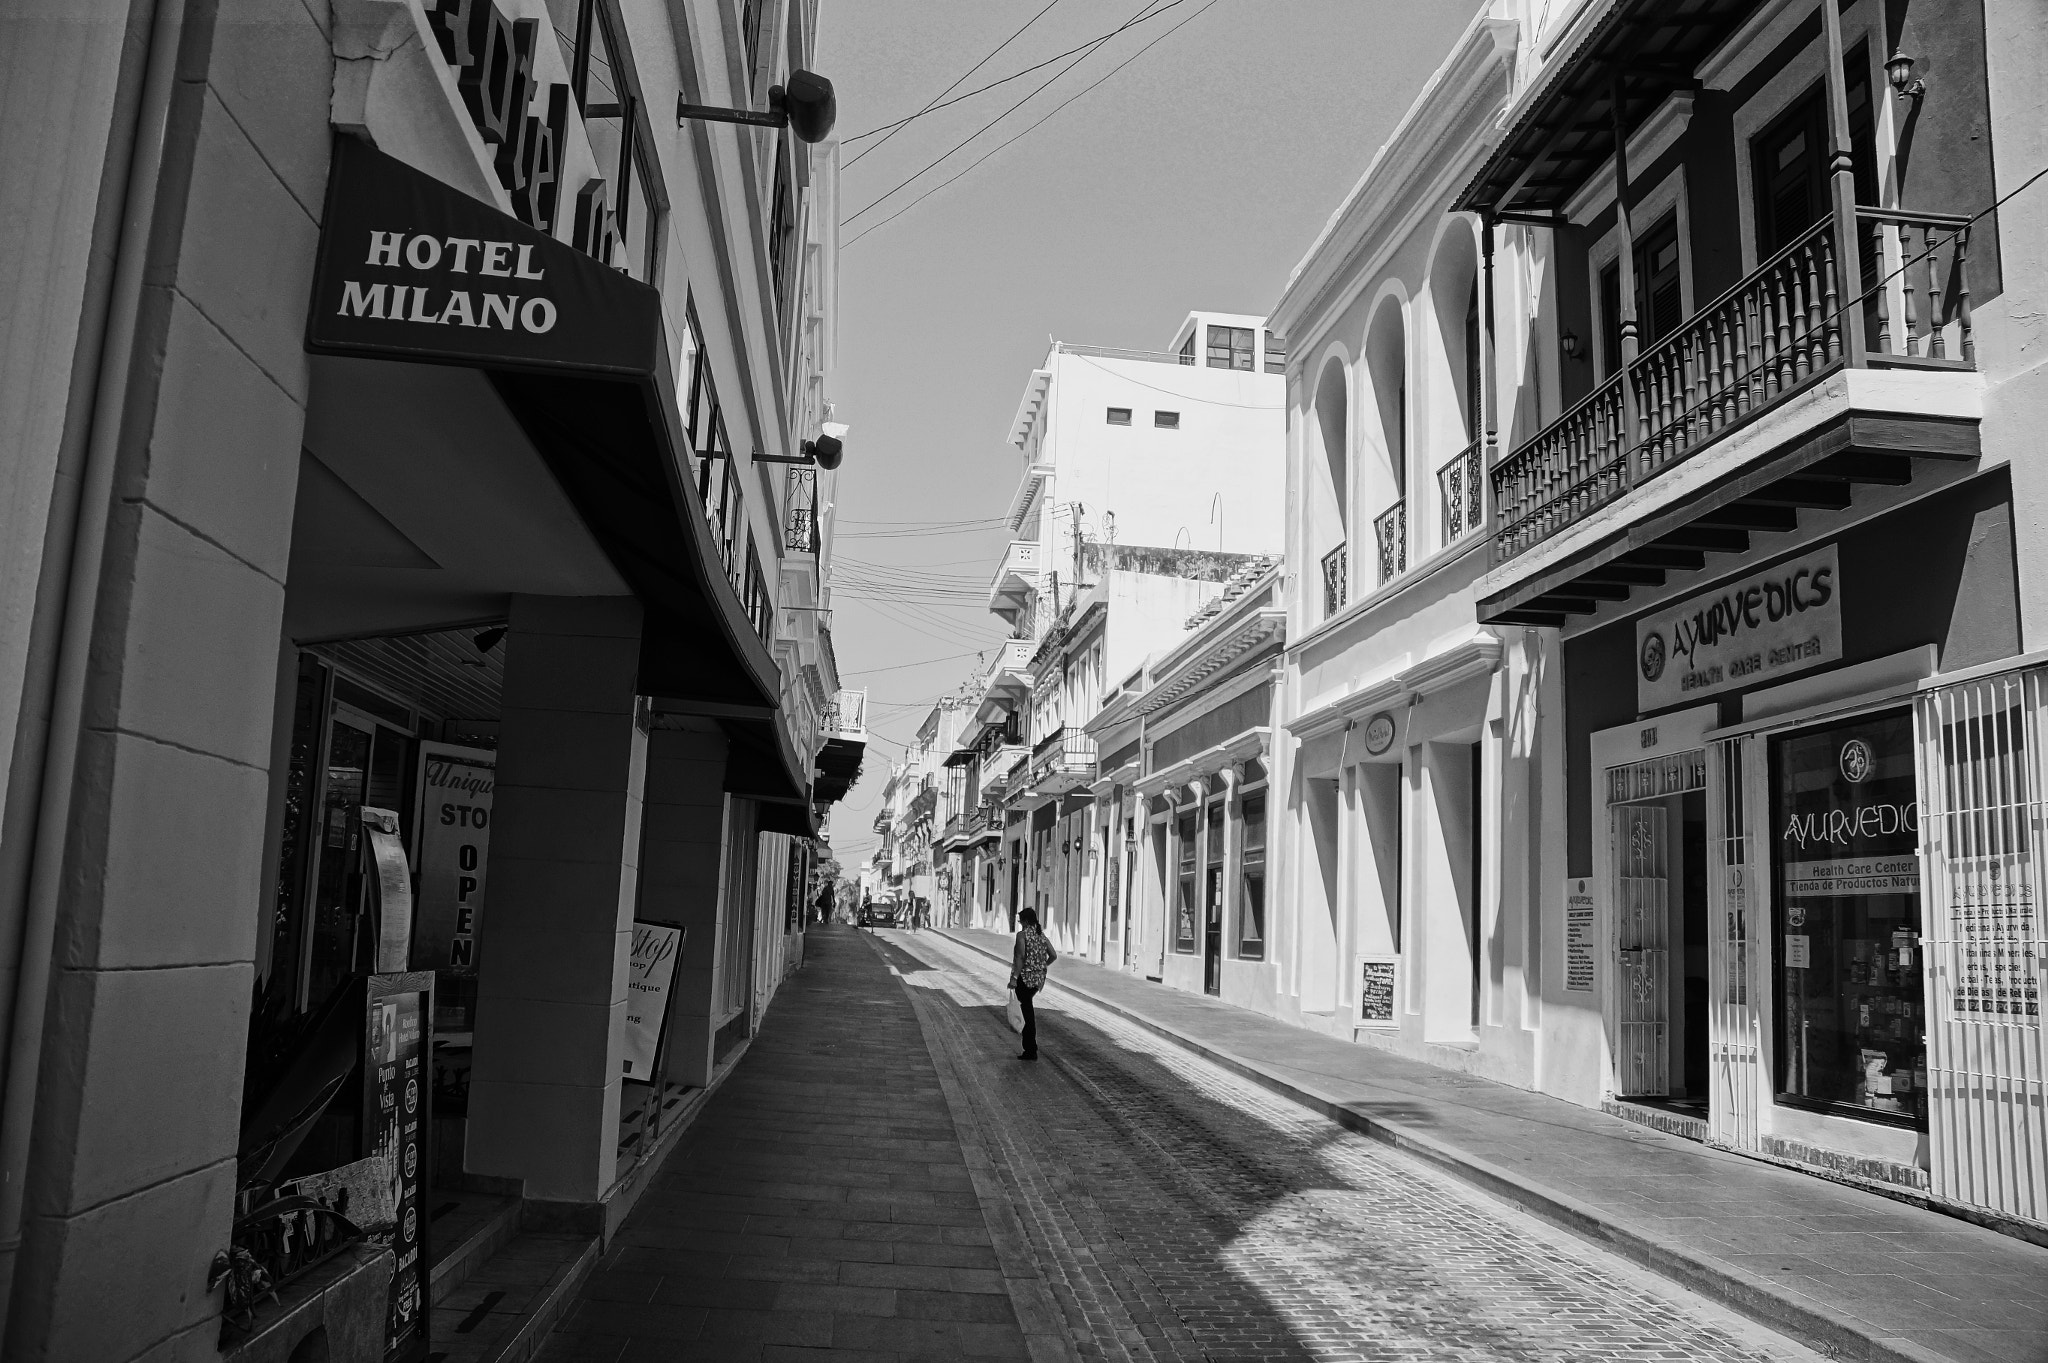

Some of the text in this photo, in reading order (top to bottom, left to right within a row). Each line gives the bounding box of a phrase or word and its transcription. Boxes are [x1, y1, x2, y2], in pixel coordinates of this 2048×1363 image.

[366, 229, 545, 281] HOTEL
[337, 281, 558, 334] MILANO
[1672, 566, 1832, 671] AYURVEDICS
[1681, 633, 1821, 692] HEALTH CARE CENTER
[427, 762, 494, 799] Uniqu
[440, 803, 492, 829] STO
[1812, 861, 1913, 877] Health Care Center
[1790, 881, 1820, 892] Tienda
[1823, 880, 1833, 890] de
[1836, 878, 1888, 890] Productos
[451, 844, 477, 966] OPEN
[628, 983, 661, 993] tique
[1968, 987, 1990, 996] Dieas
[626, 1015, 641, 1024] ng
